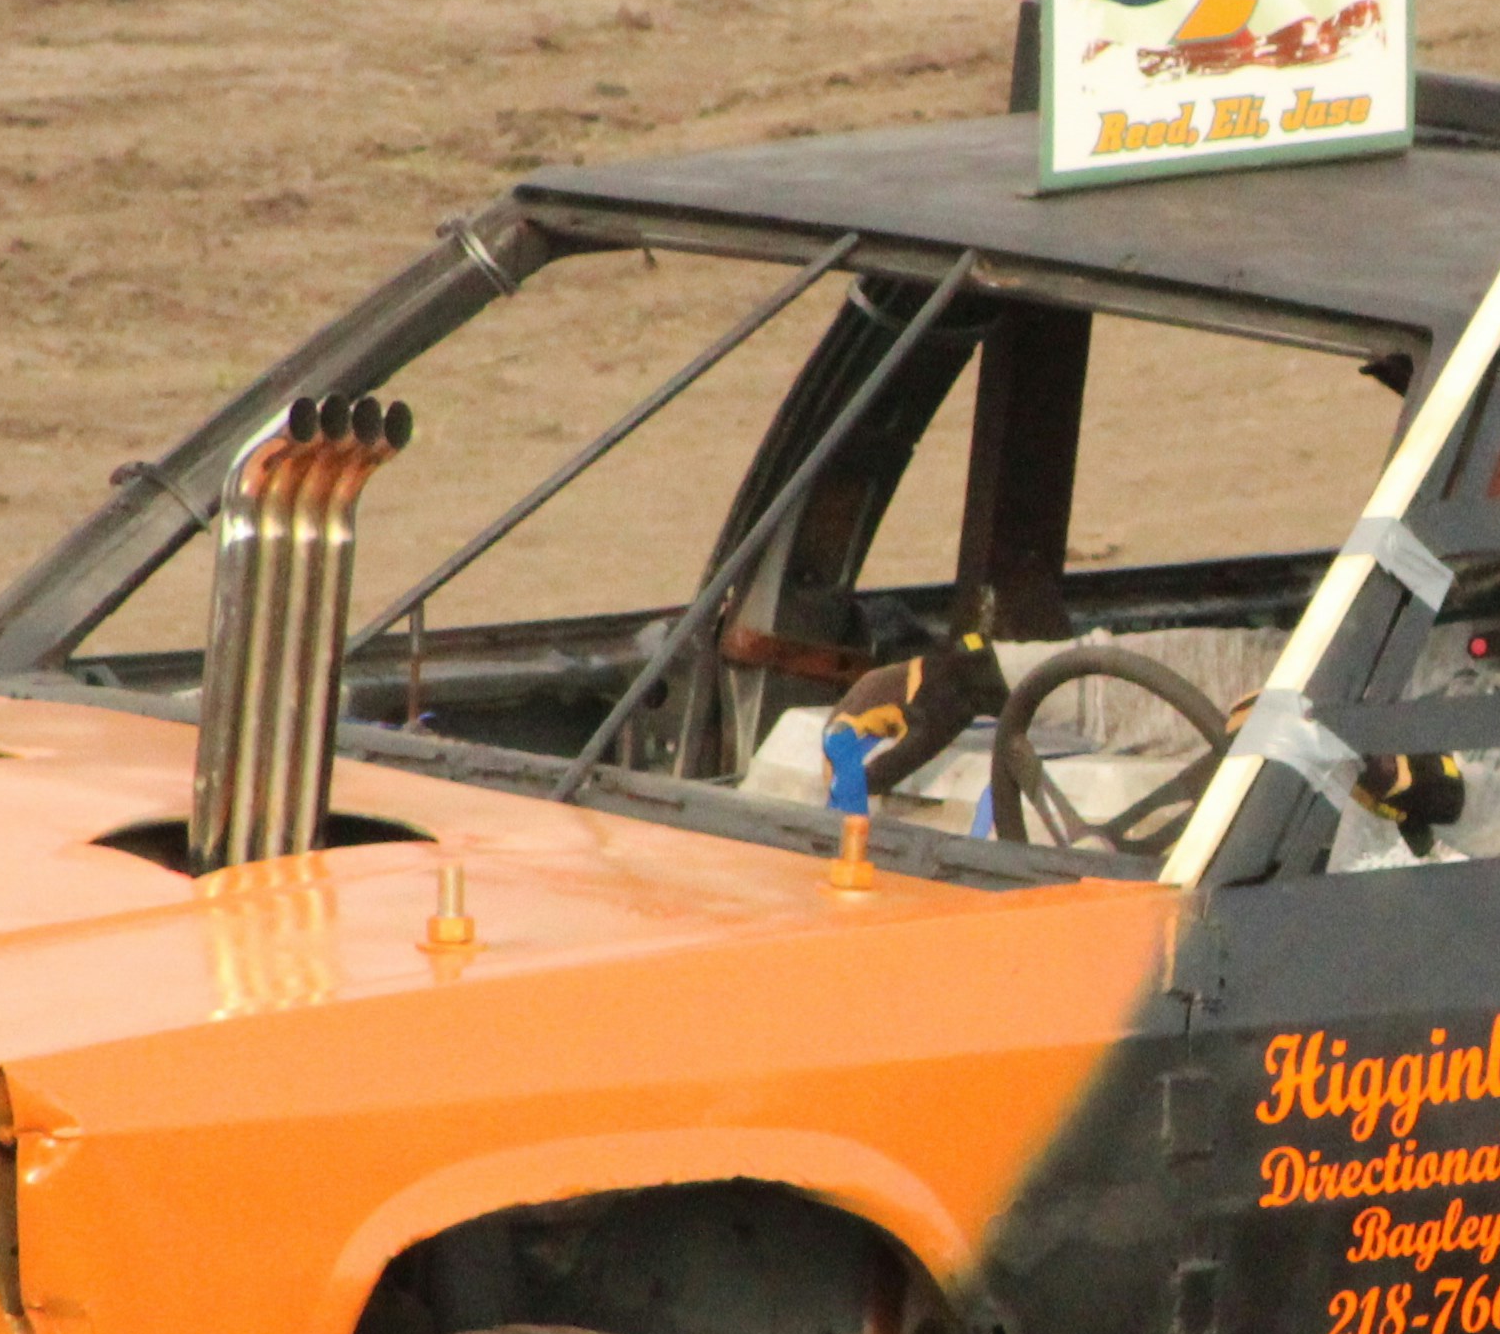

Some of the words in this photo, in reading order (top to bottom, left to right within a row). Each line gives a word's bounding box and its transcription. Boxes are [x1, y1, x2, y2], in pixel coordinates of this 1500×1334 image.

[1090, 103, 1199, 156] Reed,
[1203, 94, 1270, 143] Eli,
[1279, 87, 1373, 132] Jase
